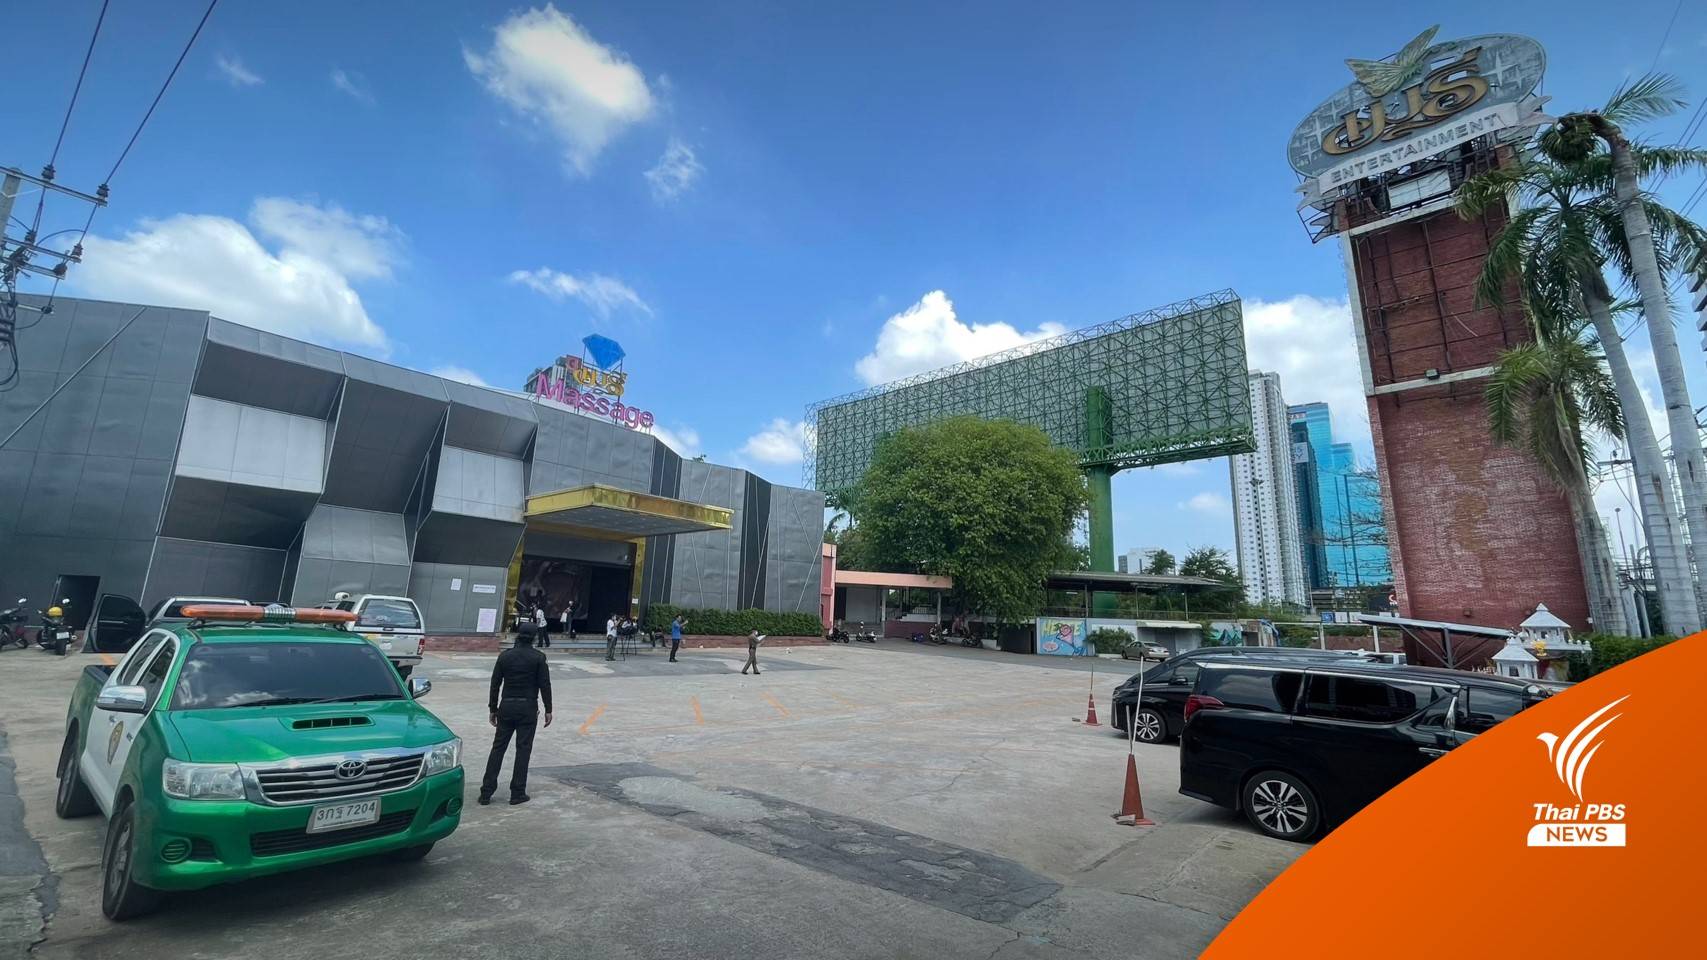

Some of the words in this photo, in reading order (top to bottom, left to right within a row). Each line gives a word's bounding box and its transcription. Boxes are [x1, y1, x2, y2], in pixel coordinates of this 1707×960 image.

[1330, 112, 1498, 185] ENTERTAINMENT
[536, 373, 654, 429] Massage
[347, 801, 376, 817] 7204
